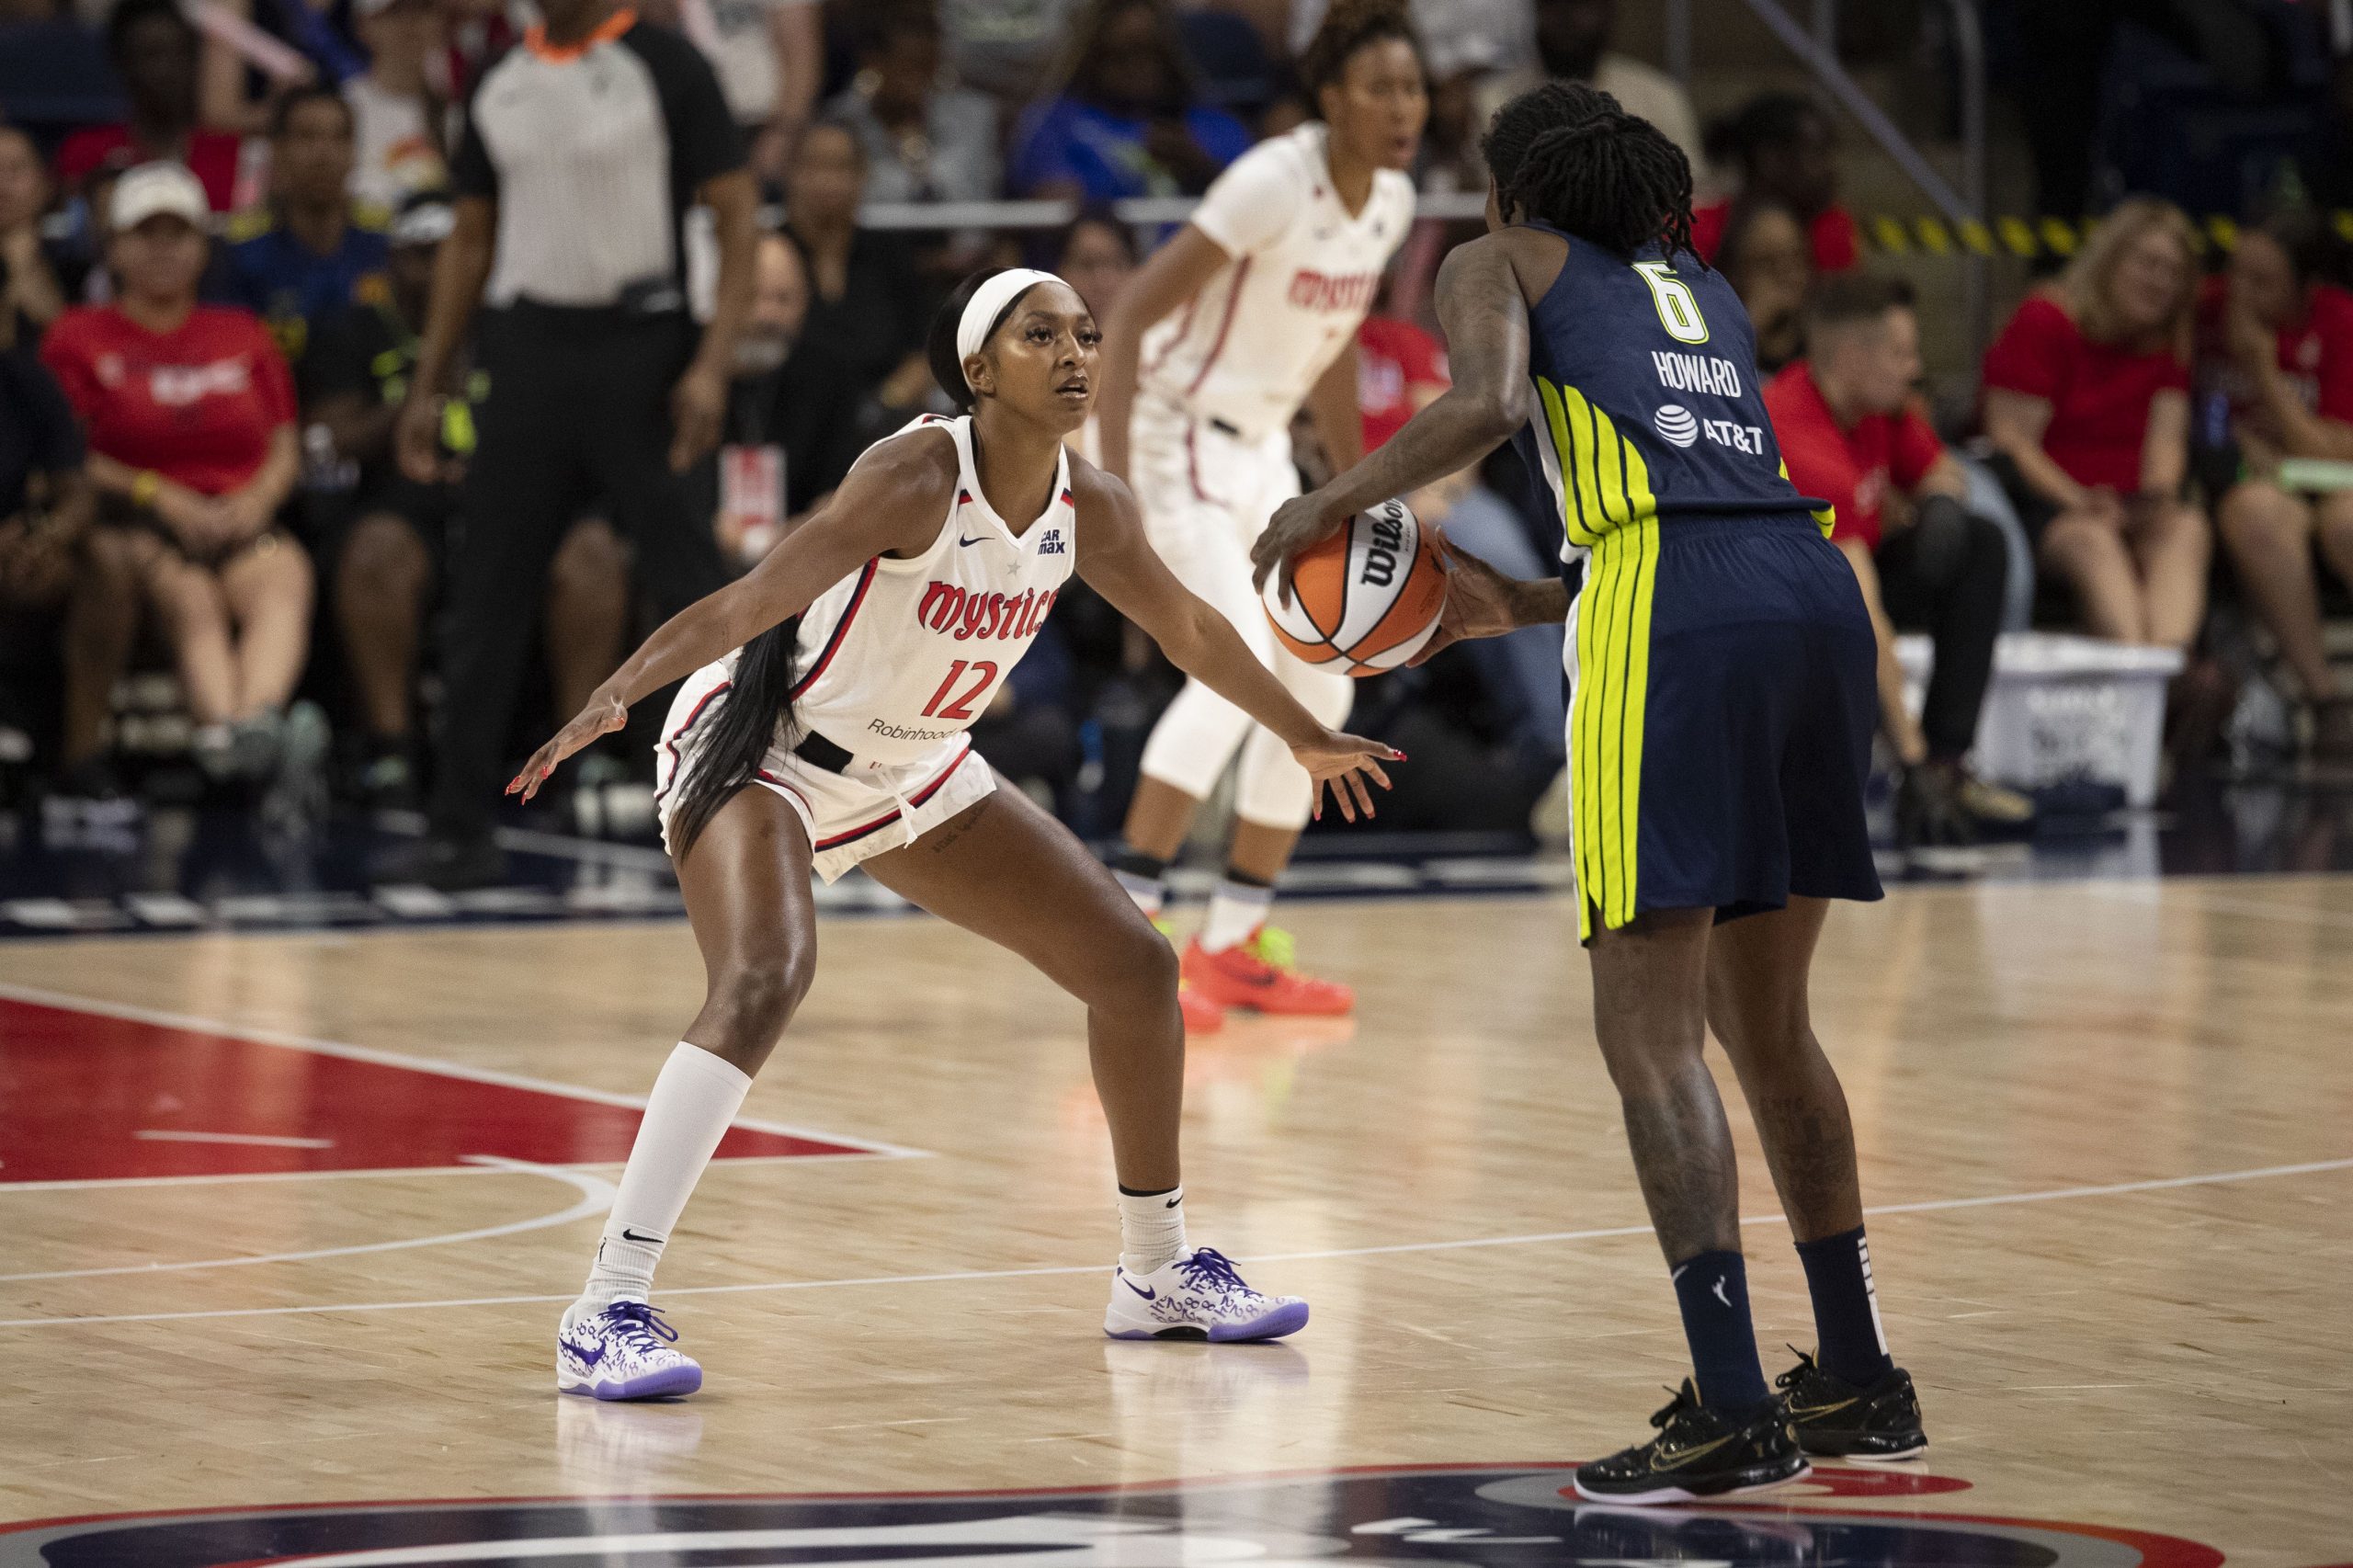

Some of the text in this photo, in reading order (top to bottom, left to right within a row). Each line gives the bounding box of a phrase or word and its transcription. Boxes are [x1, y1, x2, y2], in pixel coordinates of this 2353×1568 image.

[1631, 260, 1710, 345] 6
[1651, 350, 1742, 398] HOWARD
[1702, 417, 1763, 455] AT&T
[1038, 540, 1065, 555] max
[1360, 499, 1404, 587] Wilson
[920, 659, 998, 721] 12
[867, 717, 958, 741] Robinhood
